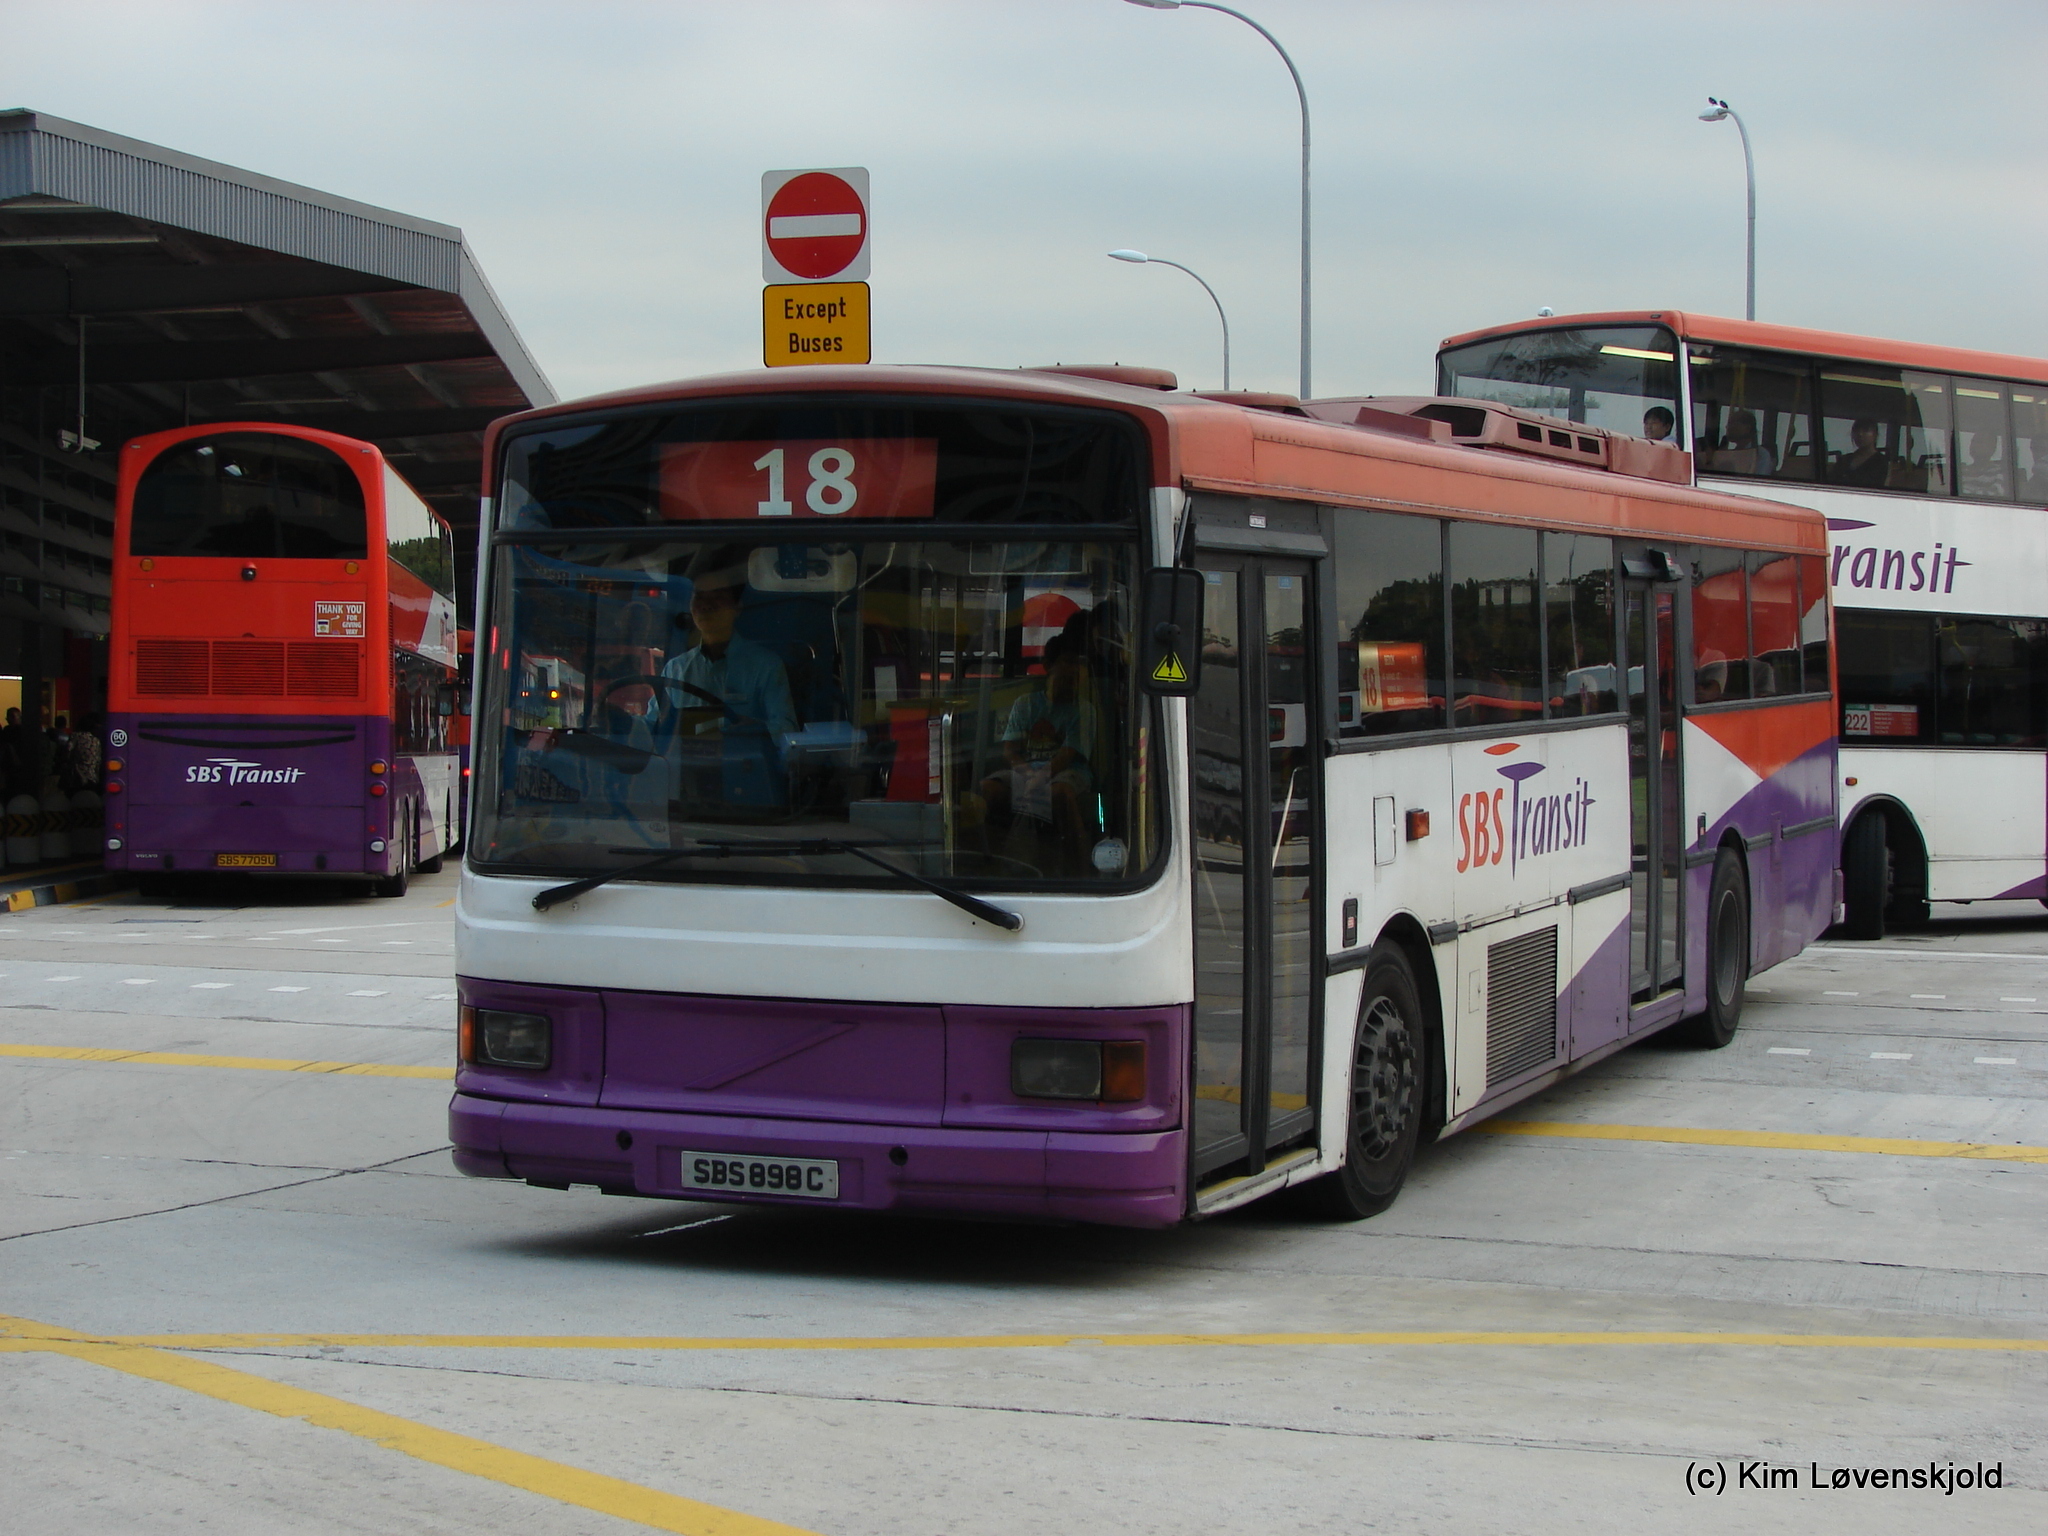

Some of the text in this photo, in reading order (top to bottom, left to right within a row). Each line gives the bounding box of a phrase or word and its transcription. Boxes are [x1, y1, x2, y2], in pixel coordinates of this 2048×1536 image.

[784, 297, 846, 323] Except
[789, 333, 843, 353] Buses
[753, 447, 858, 516] 18
[317, 604, 362, 614] THANK YOU
[1845, 714, 1868, 730] 222
[113, 732, 124, 740] 60
[186, 761, 306, 786] SBS Transit
[1457, 761, 1597, 881] SBS Transit
[218, 855, 275, 865] SBS7709U
[694, 1158, 824, 1191] SBS898C
